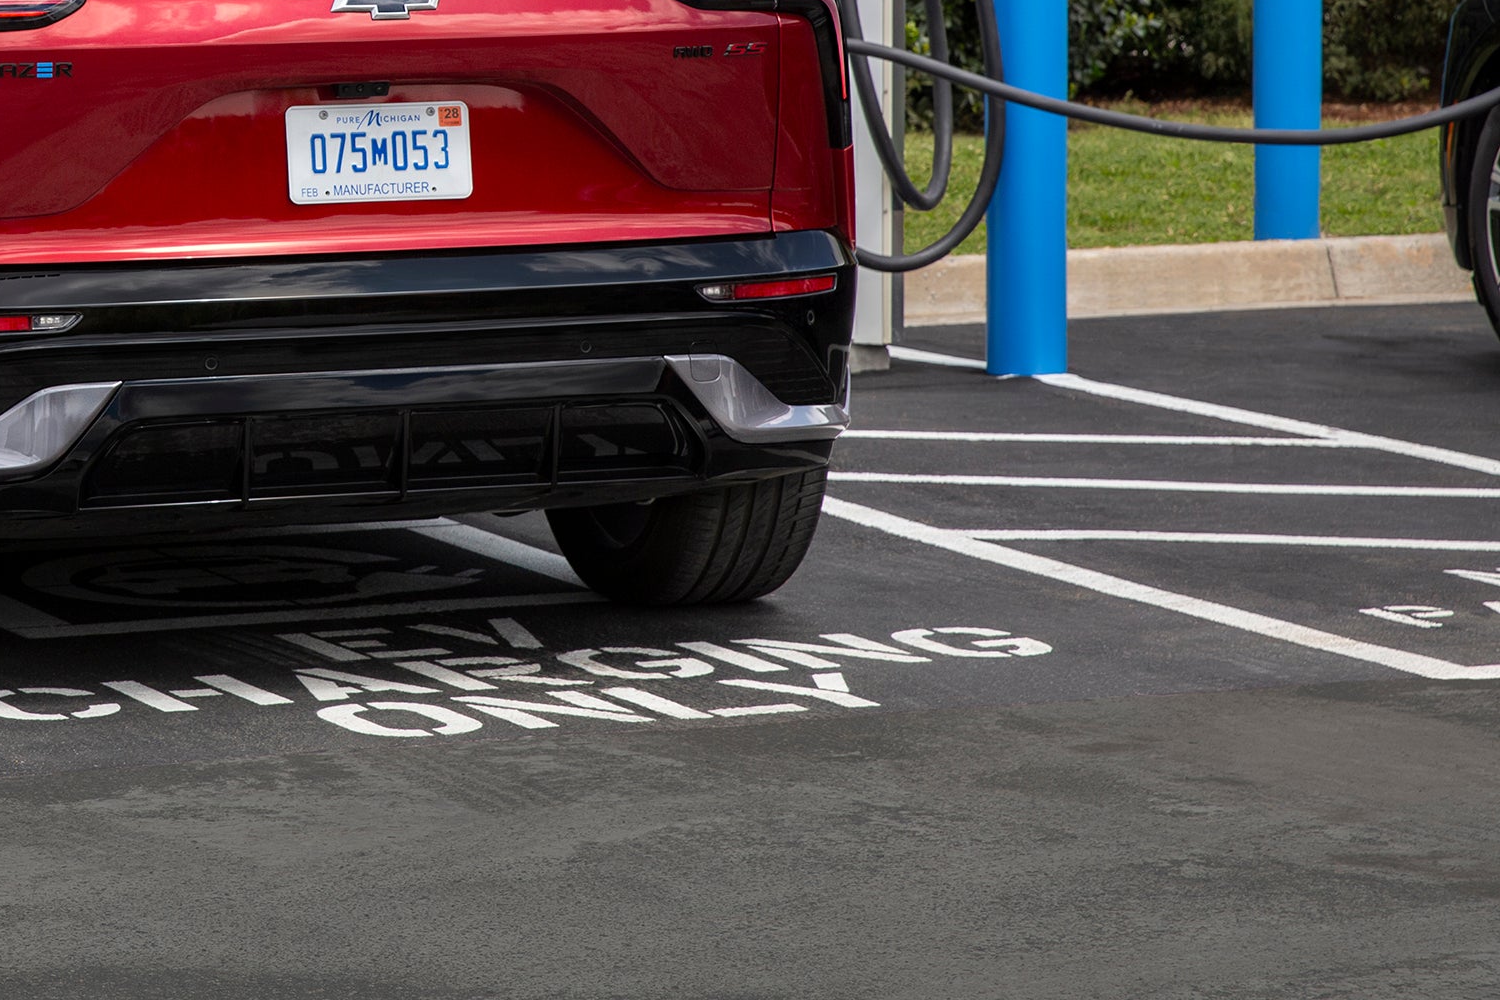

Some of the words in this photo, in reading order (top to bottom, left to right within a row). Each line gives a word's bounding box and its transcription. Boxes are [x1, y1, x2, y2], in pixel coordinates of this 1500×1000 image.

[723, 42, 768, 56] SS
[336, 116, 360, 124] PURE
[357, 109, 421, 130] MICHIGAN
[444, 107, 459, 119] 28
[309, 129, 450, 174] 075M053
[301, 187, 319, 198] FEB
[333, 181, 429, 197] MANUFACTURER
[273, 616, 544, 662] EV
[316, 672, 880, 737] ONLY
